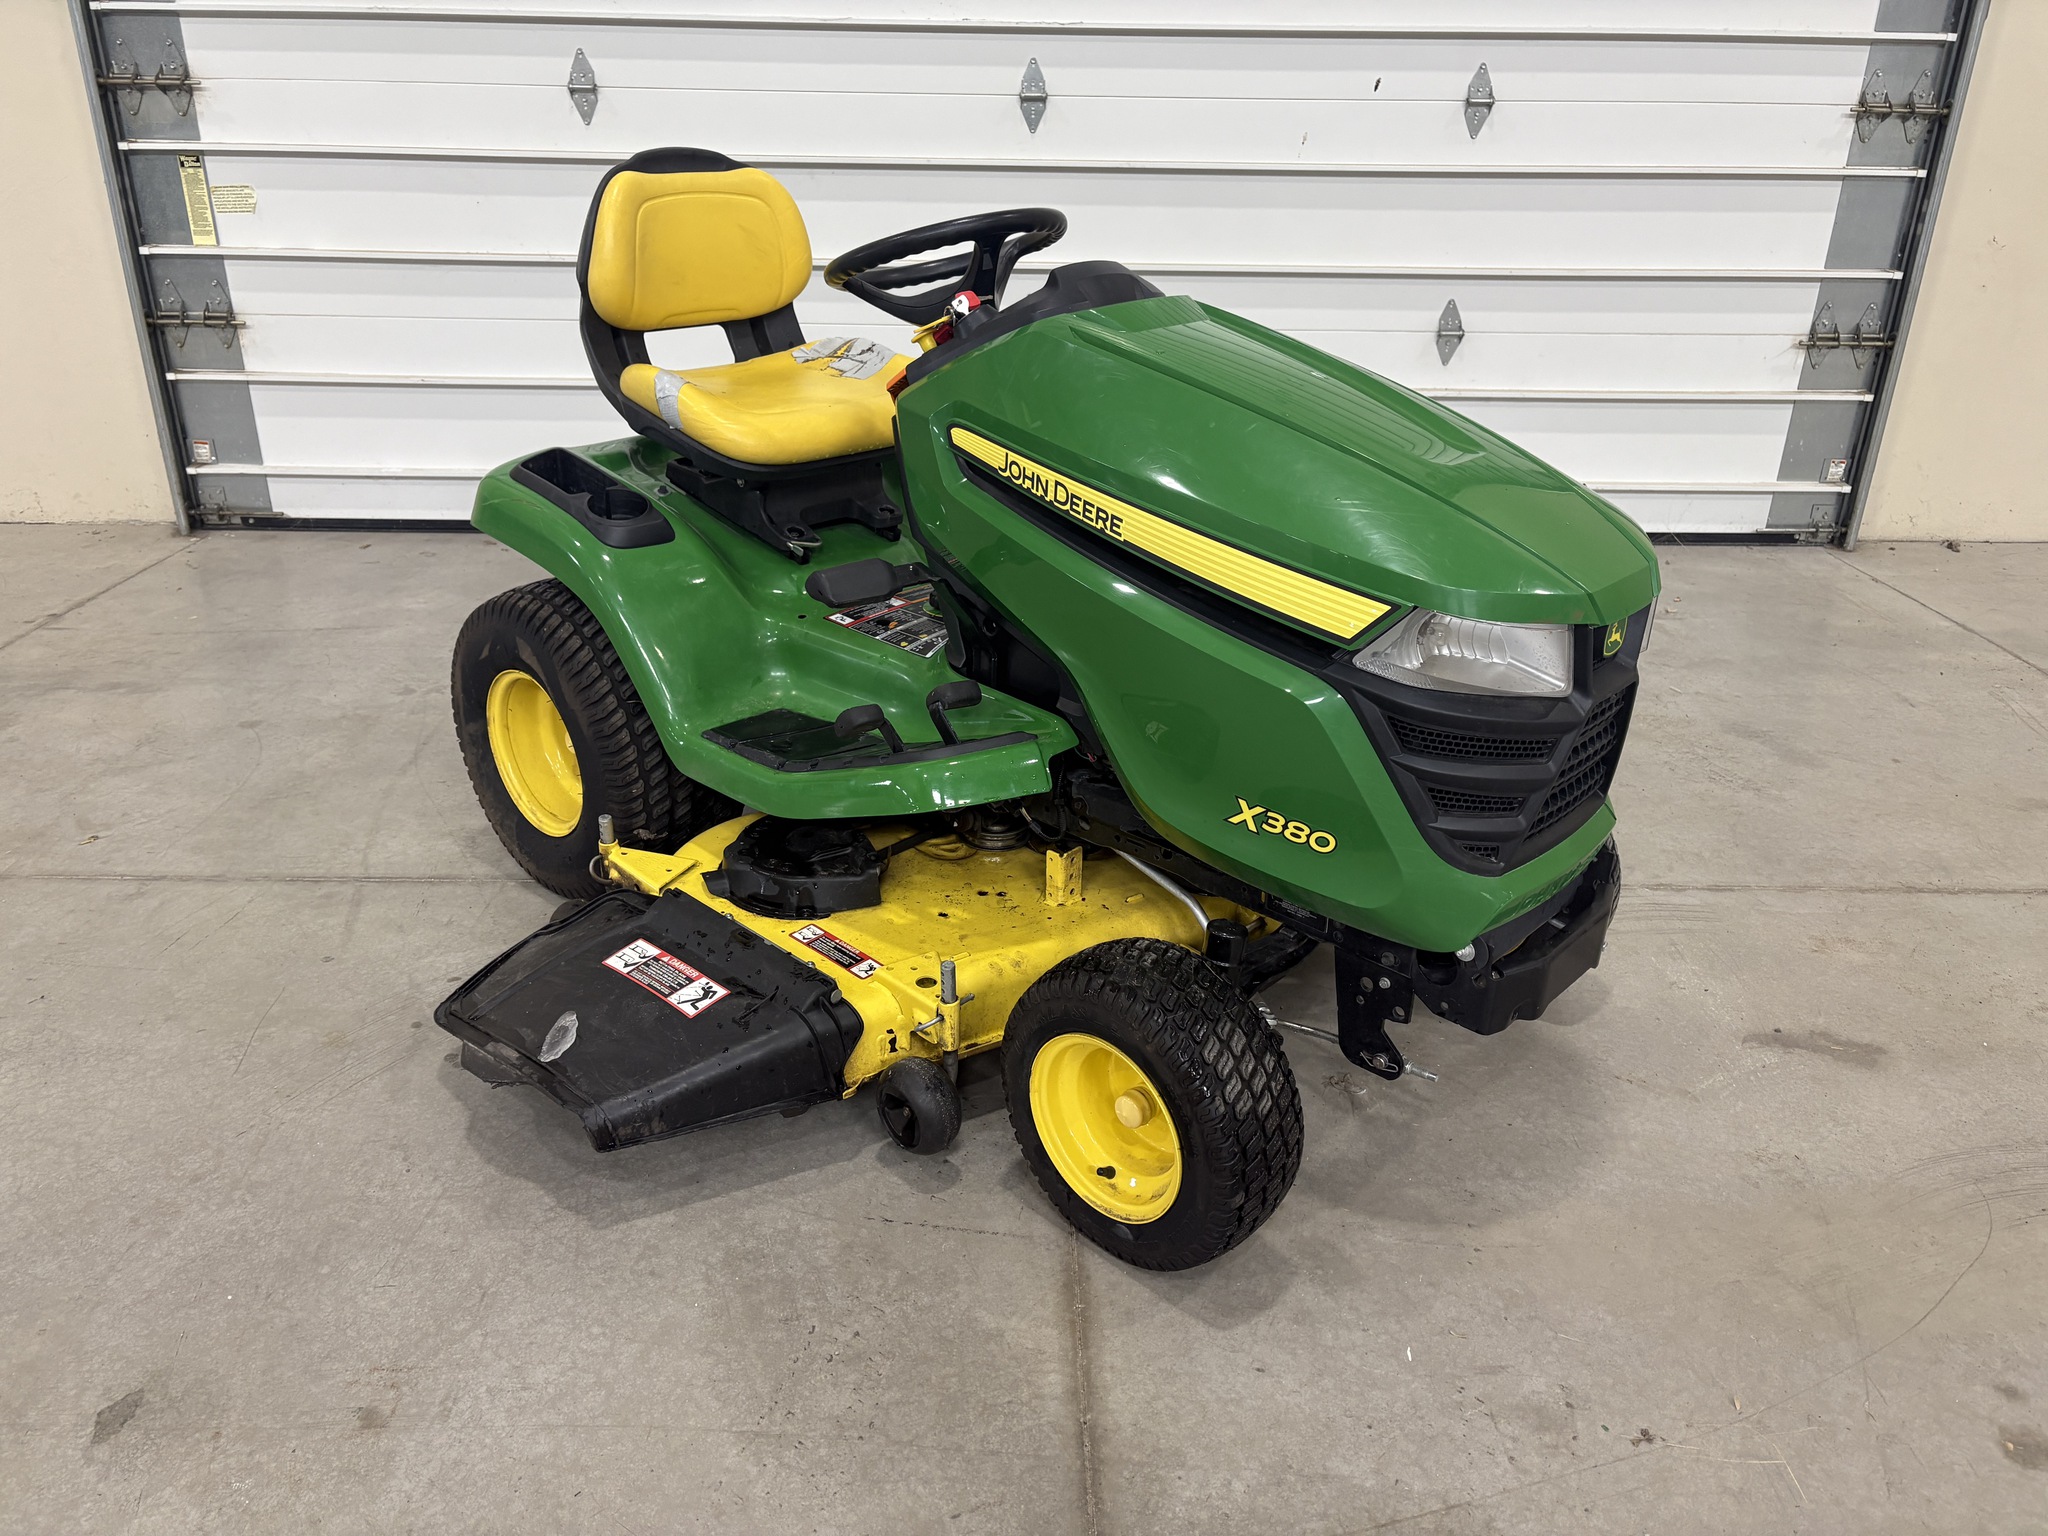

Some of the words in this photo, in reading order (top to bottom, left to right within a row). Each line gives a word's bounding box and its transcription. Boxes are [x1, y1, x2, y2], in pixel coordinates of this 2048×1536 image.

[998, 452, 1049, 498] JOHN
[1054, 480, 1123, 538] DEERE
[1223, 795, 1338, 854] X380
[669, 958, 699, 978] DANGER
